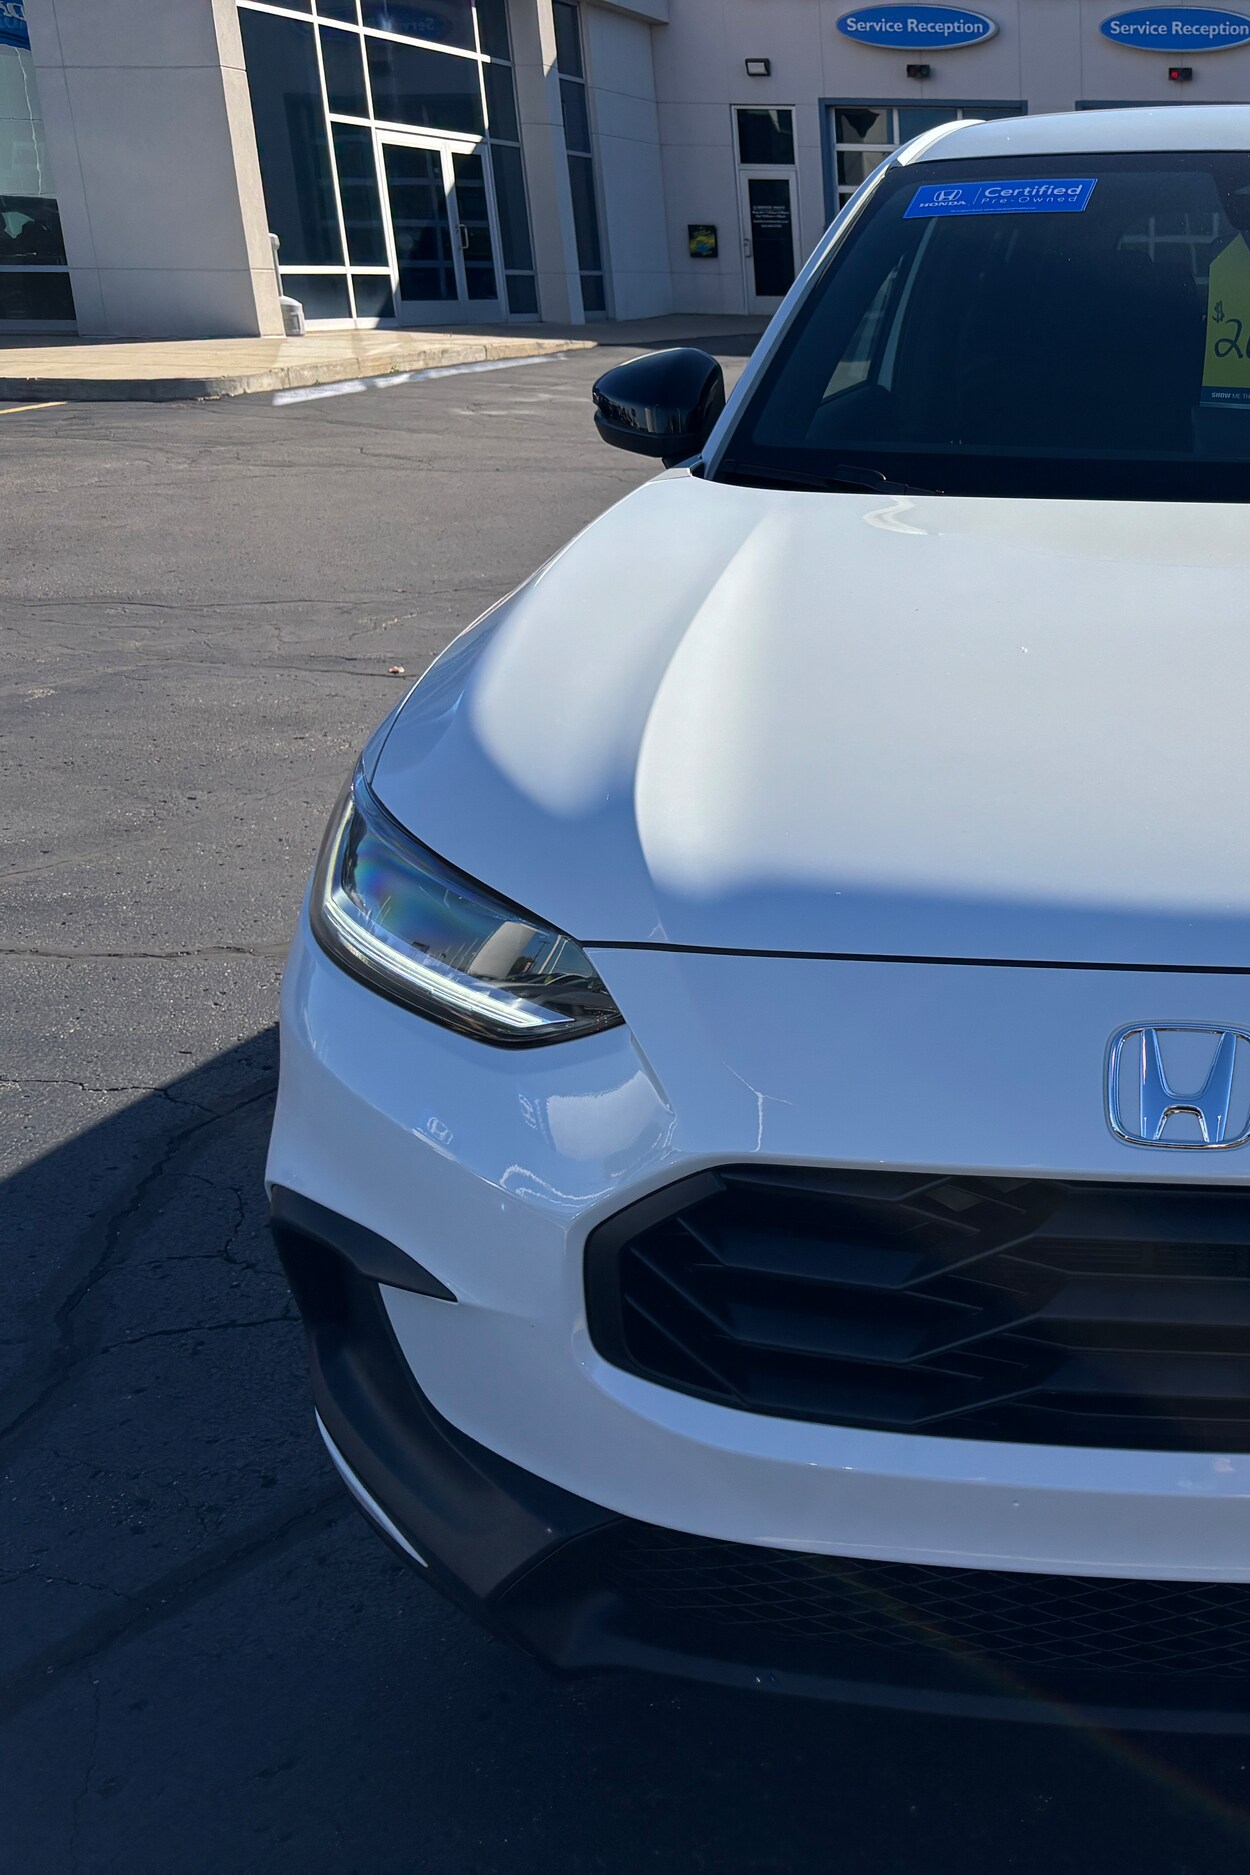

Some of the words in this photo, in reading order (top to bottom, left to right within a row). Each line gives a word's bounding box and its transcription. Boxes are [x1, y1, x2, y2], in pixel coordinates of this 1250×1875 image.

[847, 18, 903, 32] Service
[907, 19, 983, 36] Reception
[1110, 21, 1168, 35] Service
[1172, 21, 1249, 38] Reception
[984, 185, 1083, 197] Certified
[980, 195, 1078, 205] Pre-Owned
